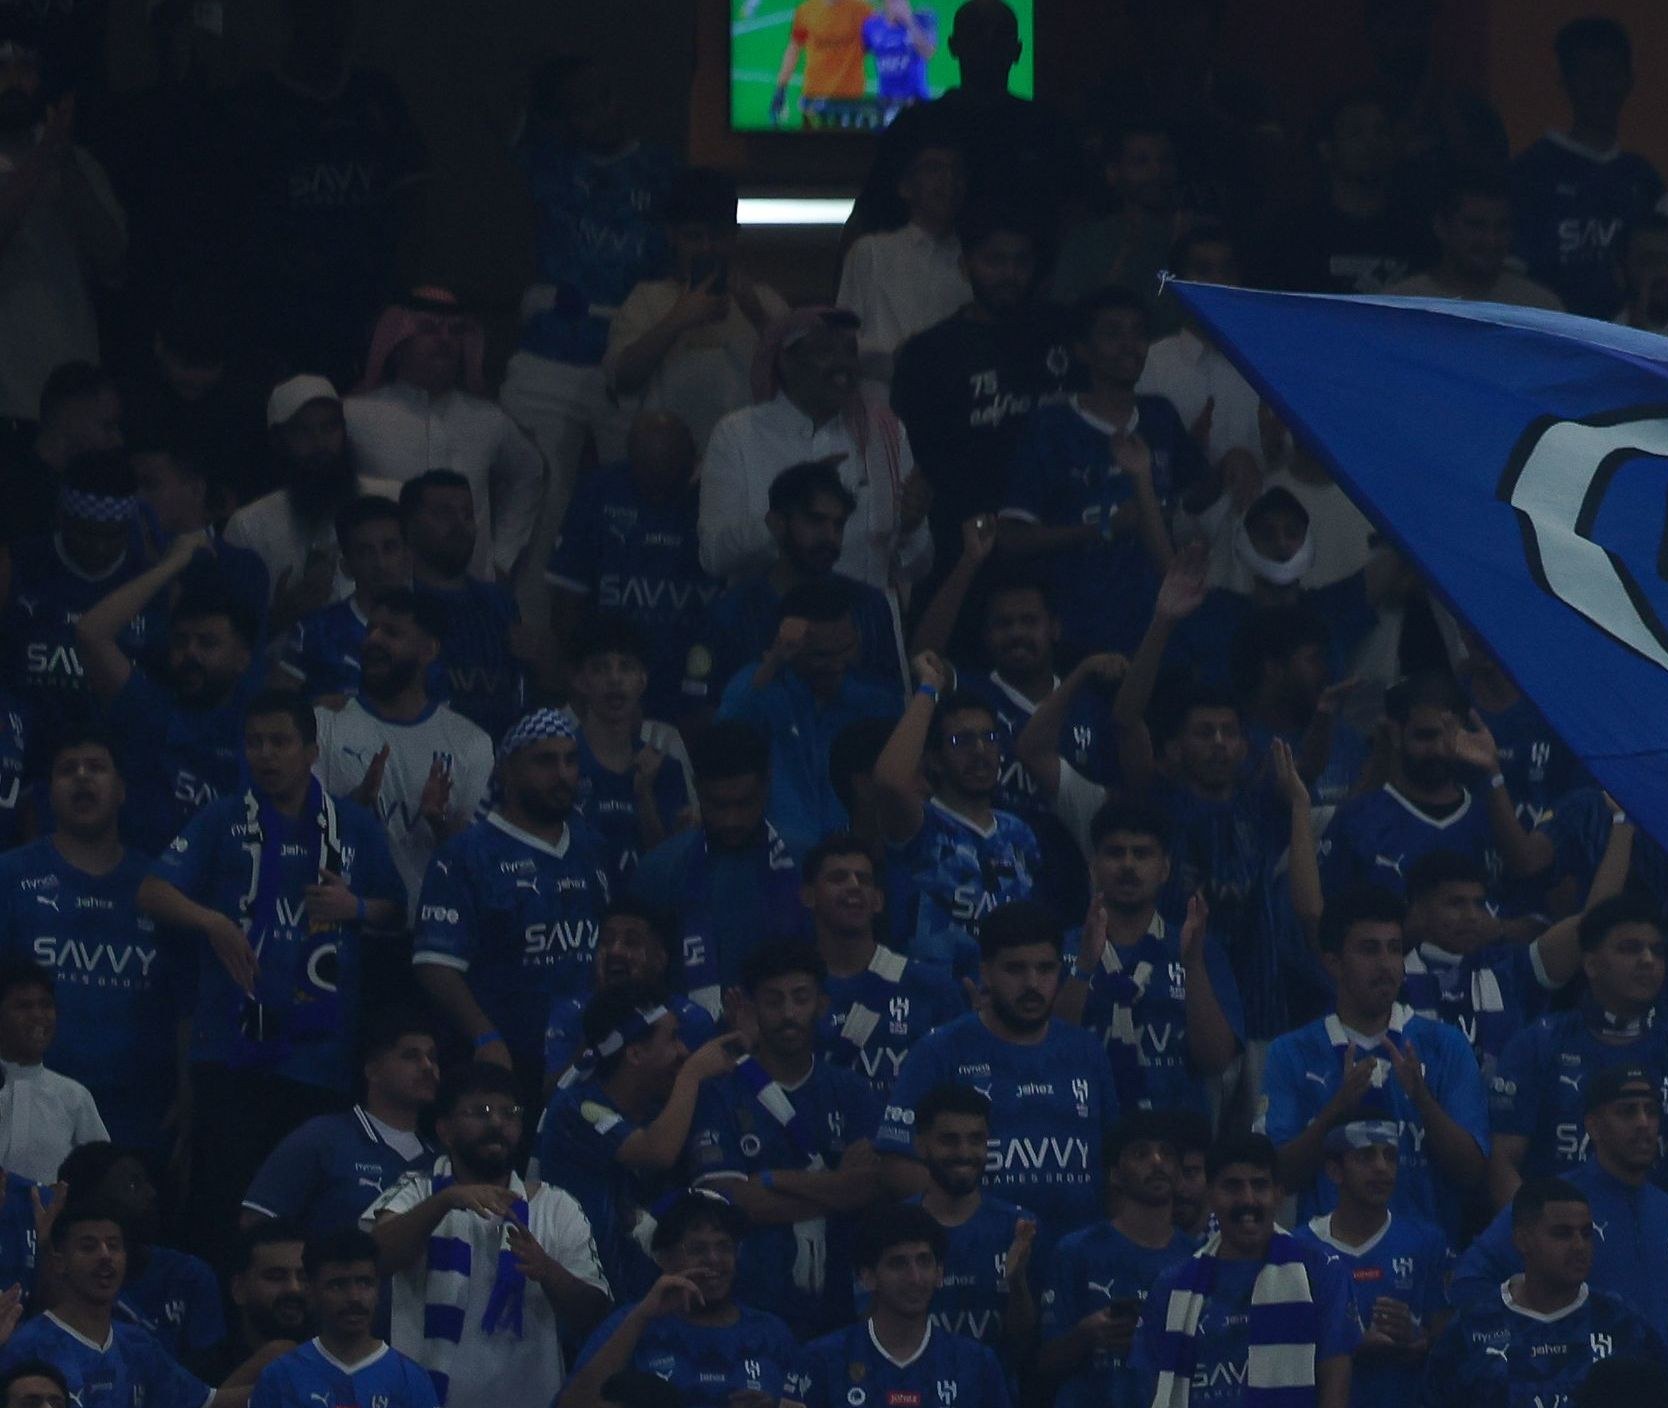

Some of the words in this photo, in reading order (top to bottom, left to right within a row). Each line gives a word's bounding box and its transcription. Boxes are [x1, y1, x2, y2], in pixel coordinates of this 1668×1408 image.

[33, 939, 157, 976] SAVVY
[984, 1138, 1087, 1169] SAVVY
[1192, 1362, 1247, 1387] SAV
